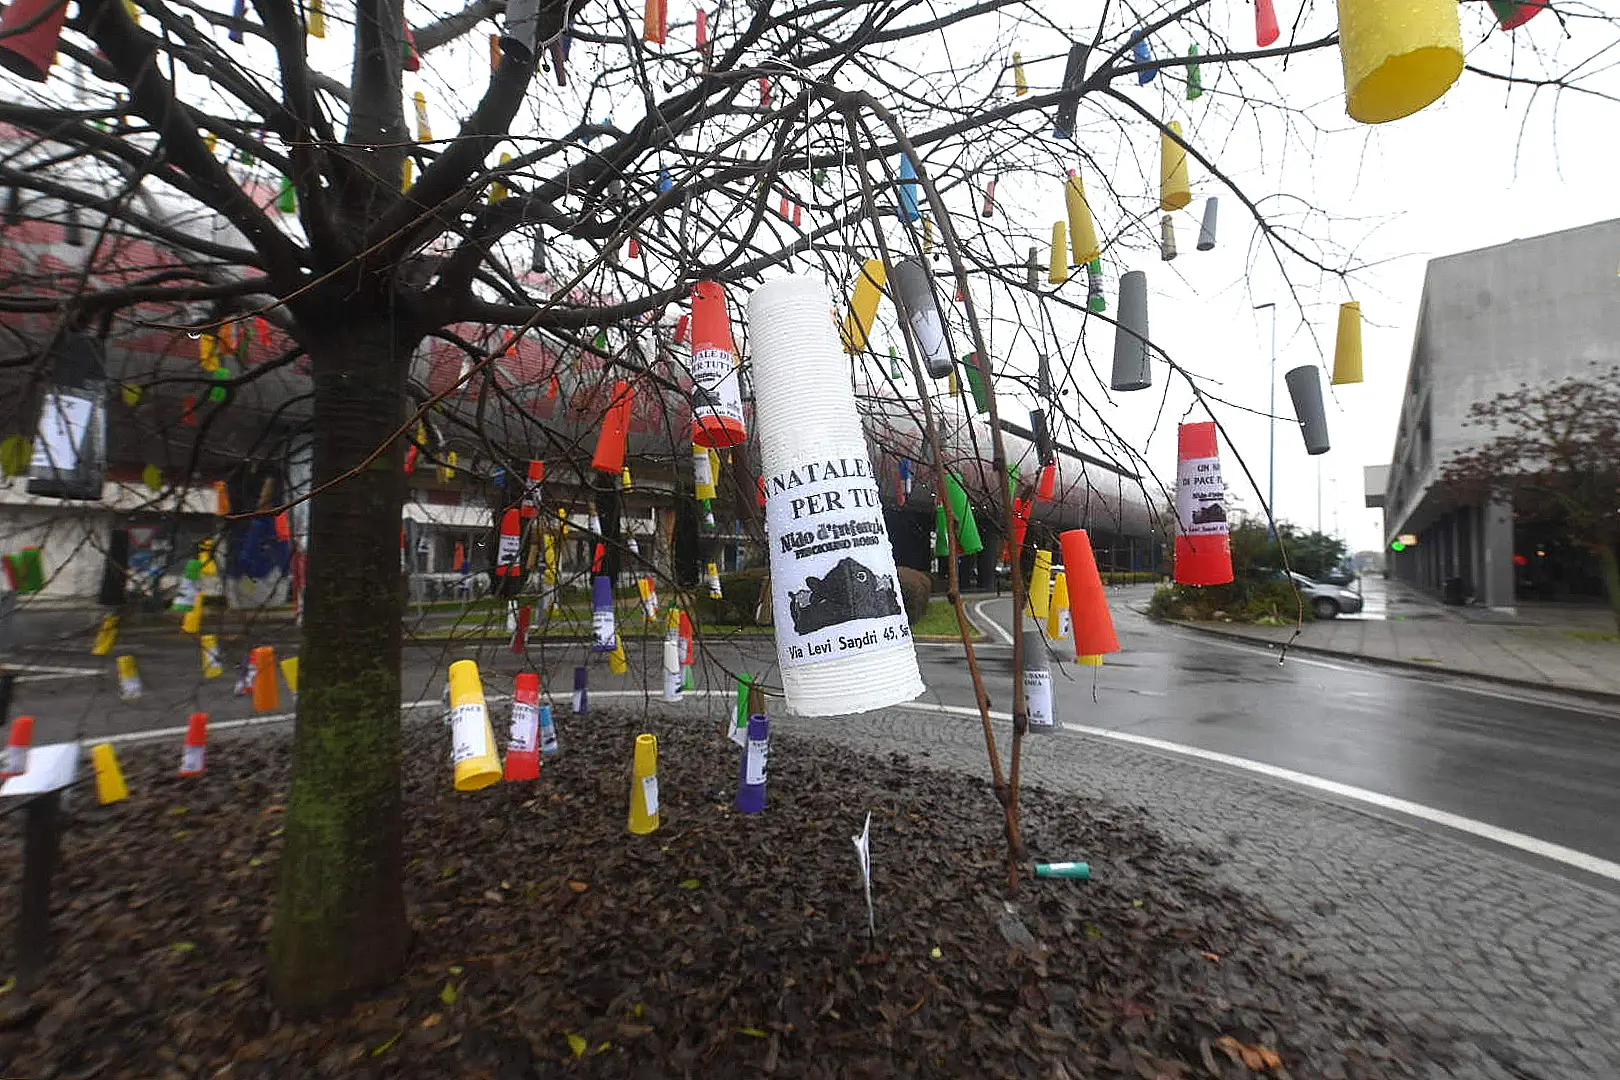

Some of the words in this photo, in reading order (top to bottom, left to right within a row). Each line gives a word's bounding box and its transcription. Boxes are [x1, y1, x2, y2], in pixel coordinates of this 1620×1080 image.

[772, 459, 867, 496] NATALE
[790, 491, 845, 520] PER
[788, 644, 804, 660] Via
[807, 639, 832, 656] Levi
[838, 629, 878, 651] Sandri
